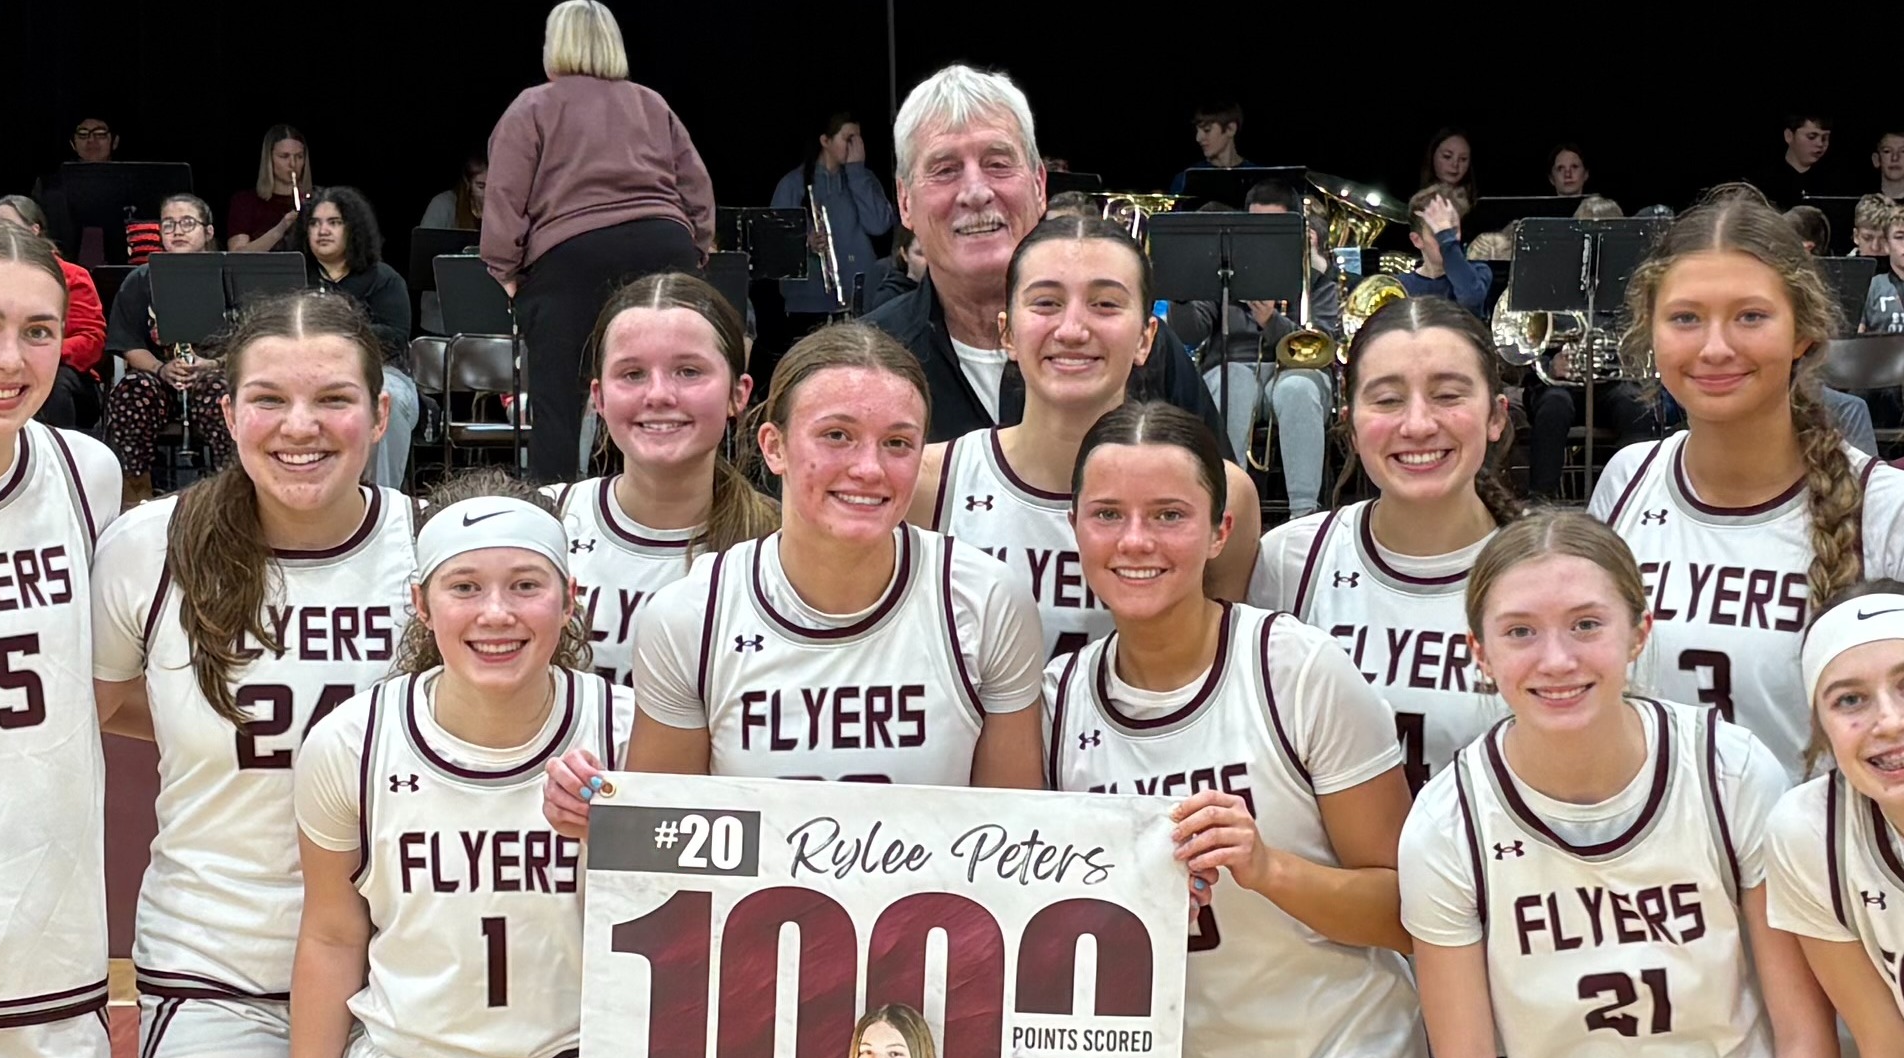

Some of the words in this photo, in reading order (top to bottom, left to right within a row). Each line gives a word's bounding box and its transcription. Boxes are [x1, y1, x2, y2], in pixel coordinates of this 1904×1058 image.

[234, 605, 394, 662] LYERS
[741, 684, 926, 752] FLYERS
[1678, 648, 1736, 725] 3
[399, 830, 581, 894] FLYERS
[654, 814, 744, 871] #20
[786, 816, 932, 879] Rylee
[951, 823, 1116, 886] Peters
[1514, 882, 1706, 956] FLYERS
[481, 916, 508, 1008] 1
[1577, 967, 1672, 1037] 21
[1012, 1026, 1078, 1051] POINTS
[1082, 1029, 1153, 1053] SCORED
